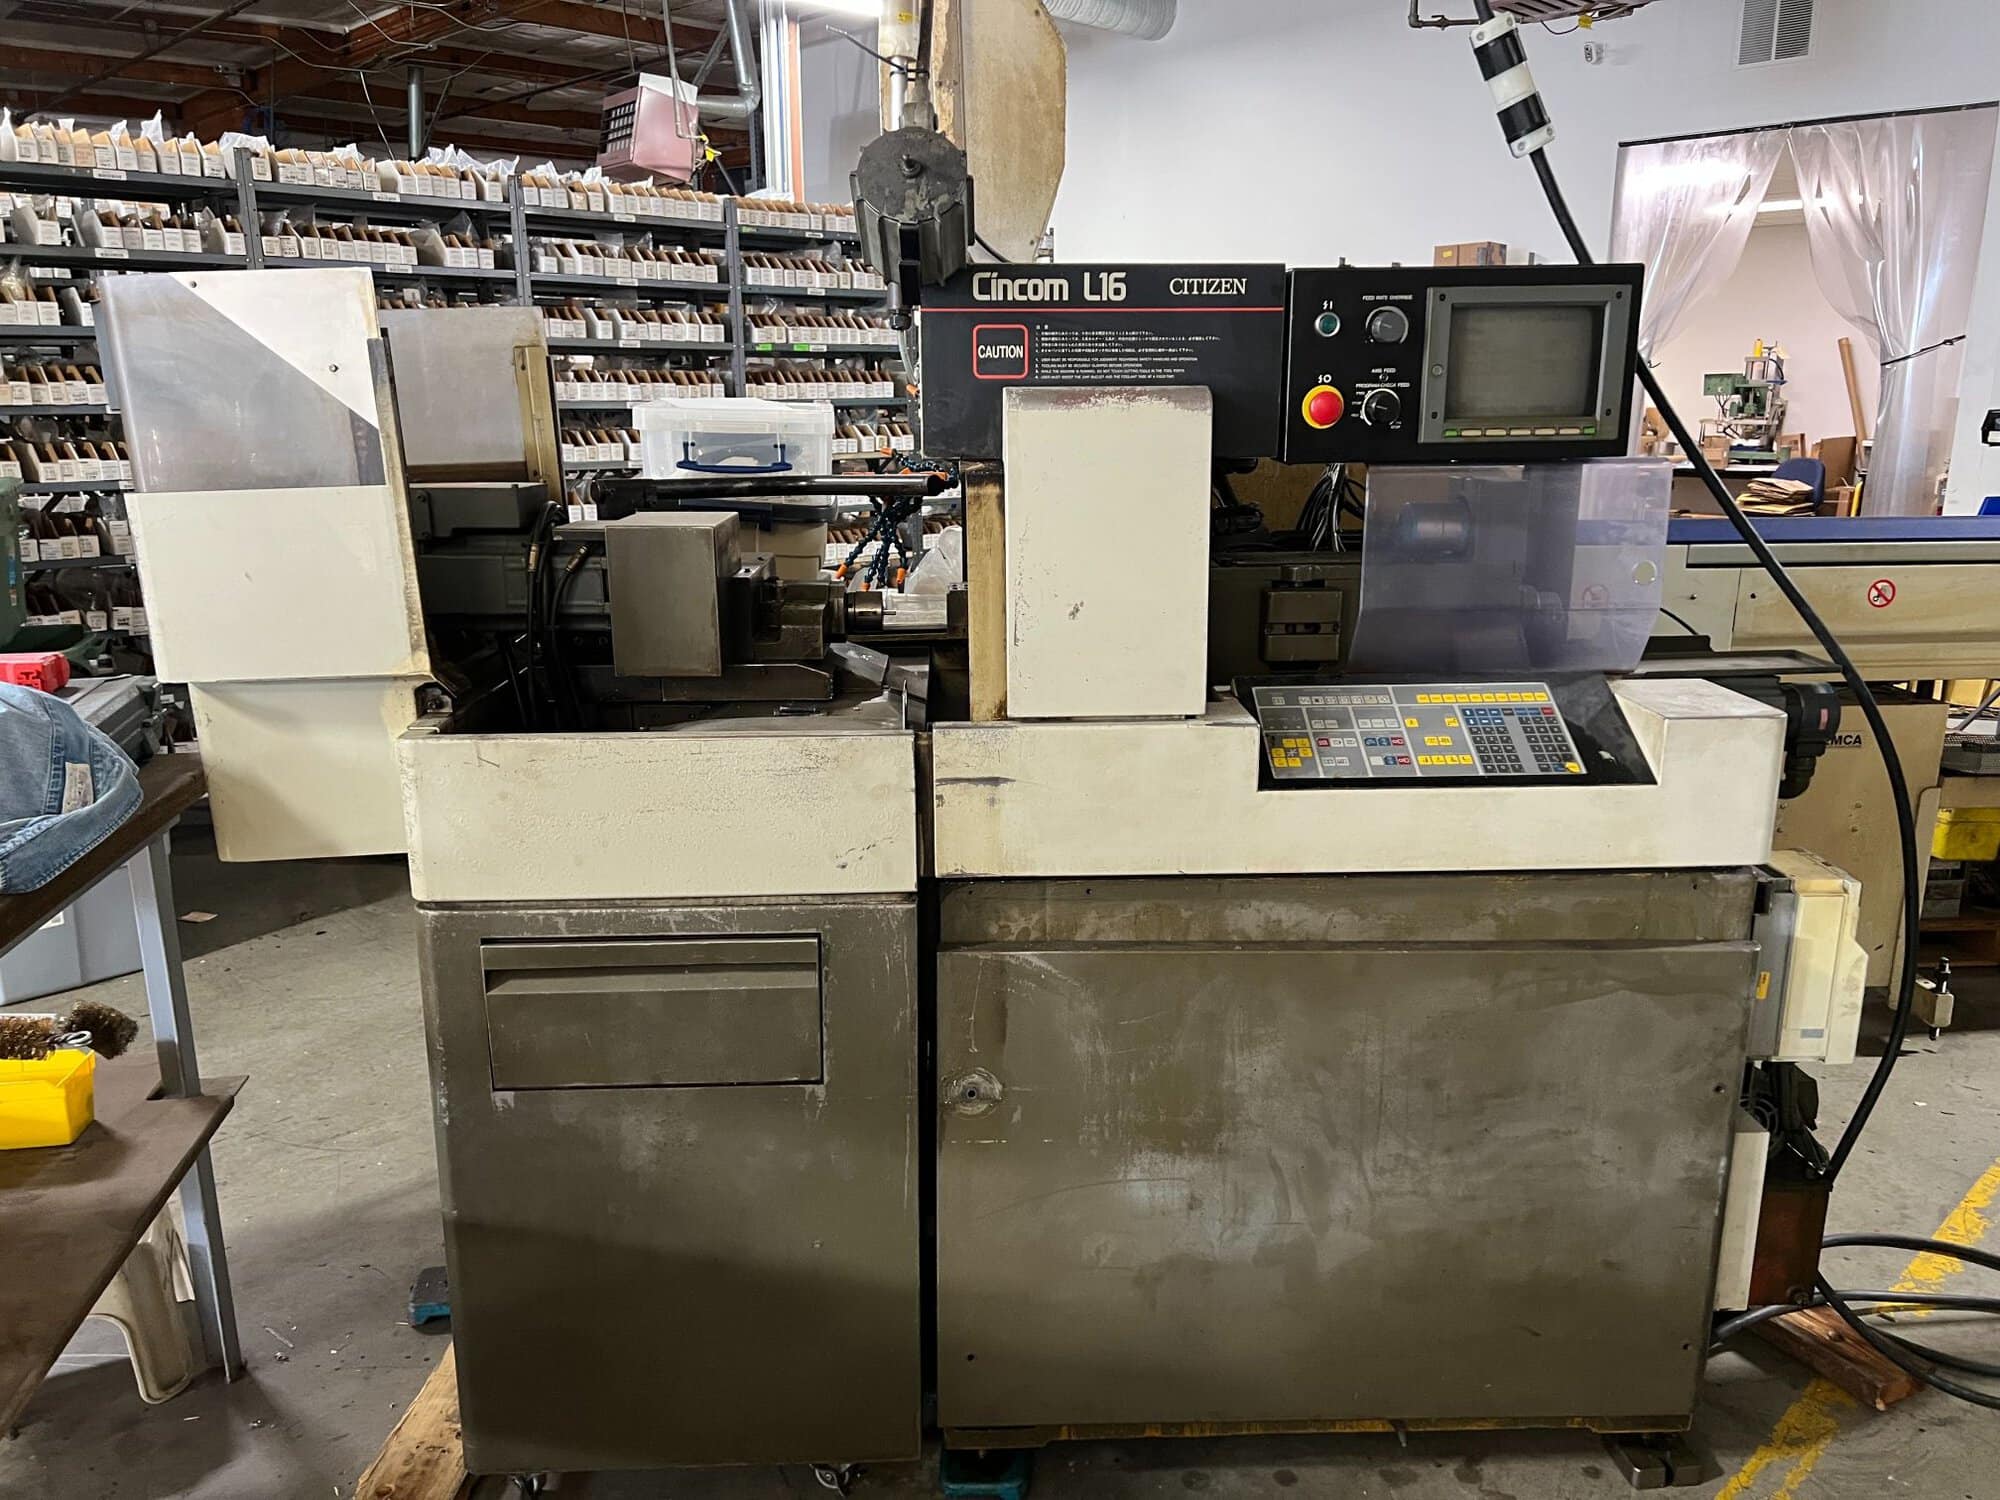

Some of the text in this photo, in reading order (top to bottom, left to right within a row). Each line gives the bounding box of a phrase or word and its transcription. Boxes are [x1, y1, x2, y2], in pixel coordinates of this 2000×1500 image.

[972, 271, 1127, 302] Cincom L16
[1168, 277, 1248, 296] CITIZEN
[977, 345, 1024, 359] CAUTION
[1826, 734, 1862, 746] MCA
